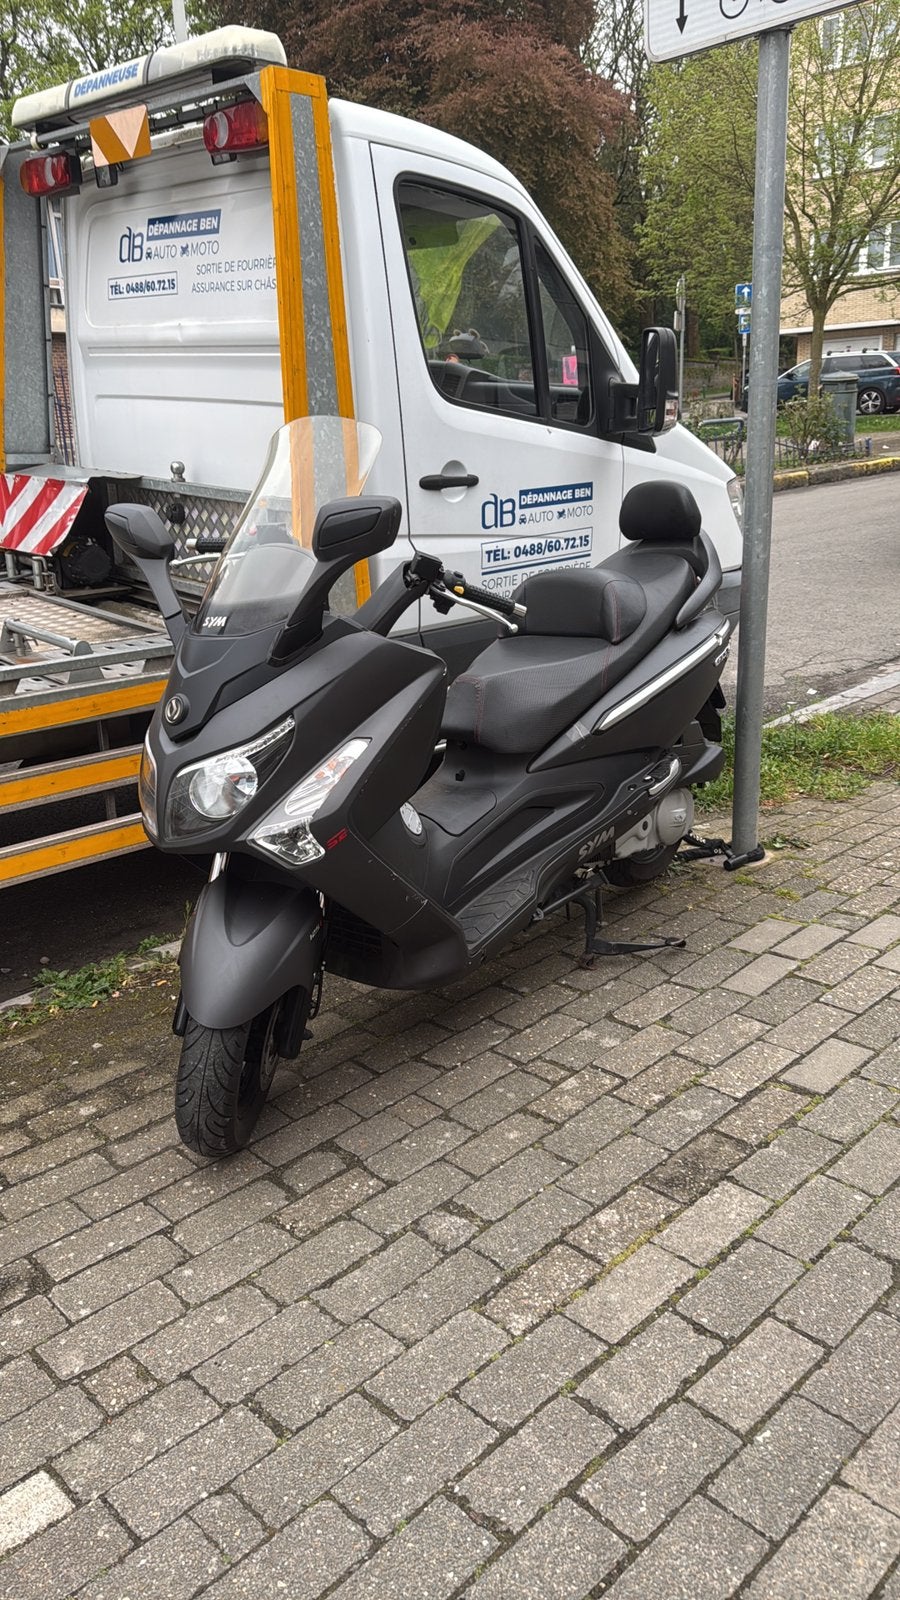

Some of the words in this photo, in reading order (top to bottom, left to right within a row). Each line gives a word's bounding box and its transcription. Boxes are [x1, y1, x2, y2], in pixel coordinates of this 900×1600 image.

[73, 62, 140, 98] DÉPANNEUSE
[148, 219, 197, 237] DÉPANNAGE
[199, 215, 219, 231] BEN
[153, 244, 178, 260] AUTO
[190, 240, 220, 257] MOTO
[196, 262, 223, 276] SORTIE
[224, 260, 236, 273] DE
[110, 281, 125, 296] TÉL:
[126, 279, 175, 294] 0488/60.72.15
[191, 280, 235, 294] ASSURANCE
[236, 279, 253, 292] SUR
[520, 491, 574, 506] DÉPANNAGE
[574, 487, 592, 499] BEN
[527, 510, 554, 524] AUTO
[567, 505, 593, 518] MOTO
[485, 546, 511, 563] TÉL:
[513, 535, 590, 557] 0488/60.72.15
[481, 574, 518, 590] SORTIE
[202, 615, 228, 629] SYM
[577, 826, 615, 863] SYM
